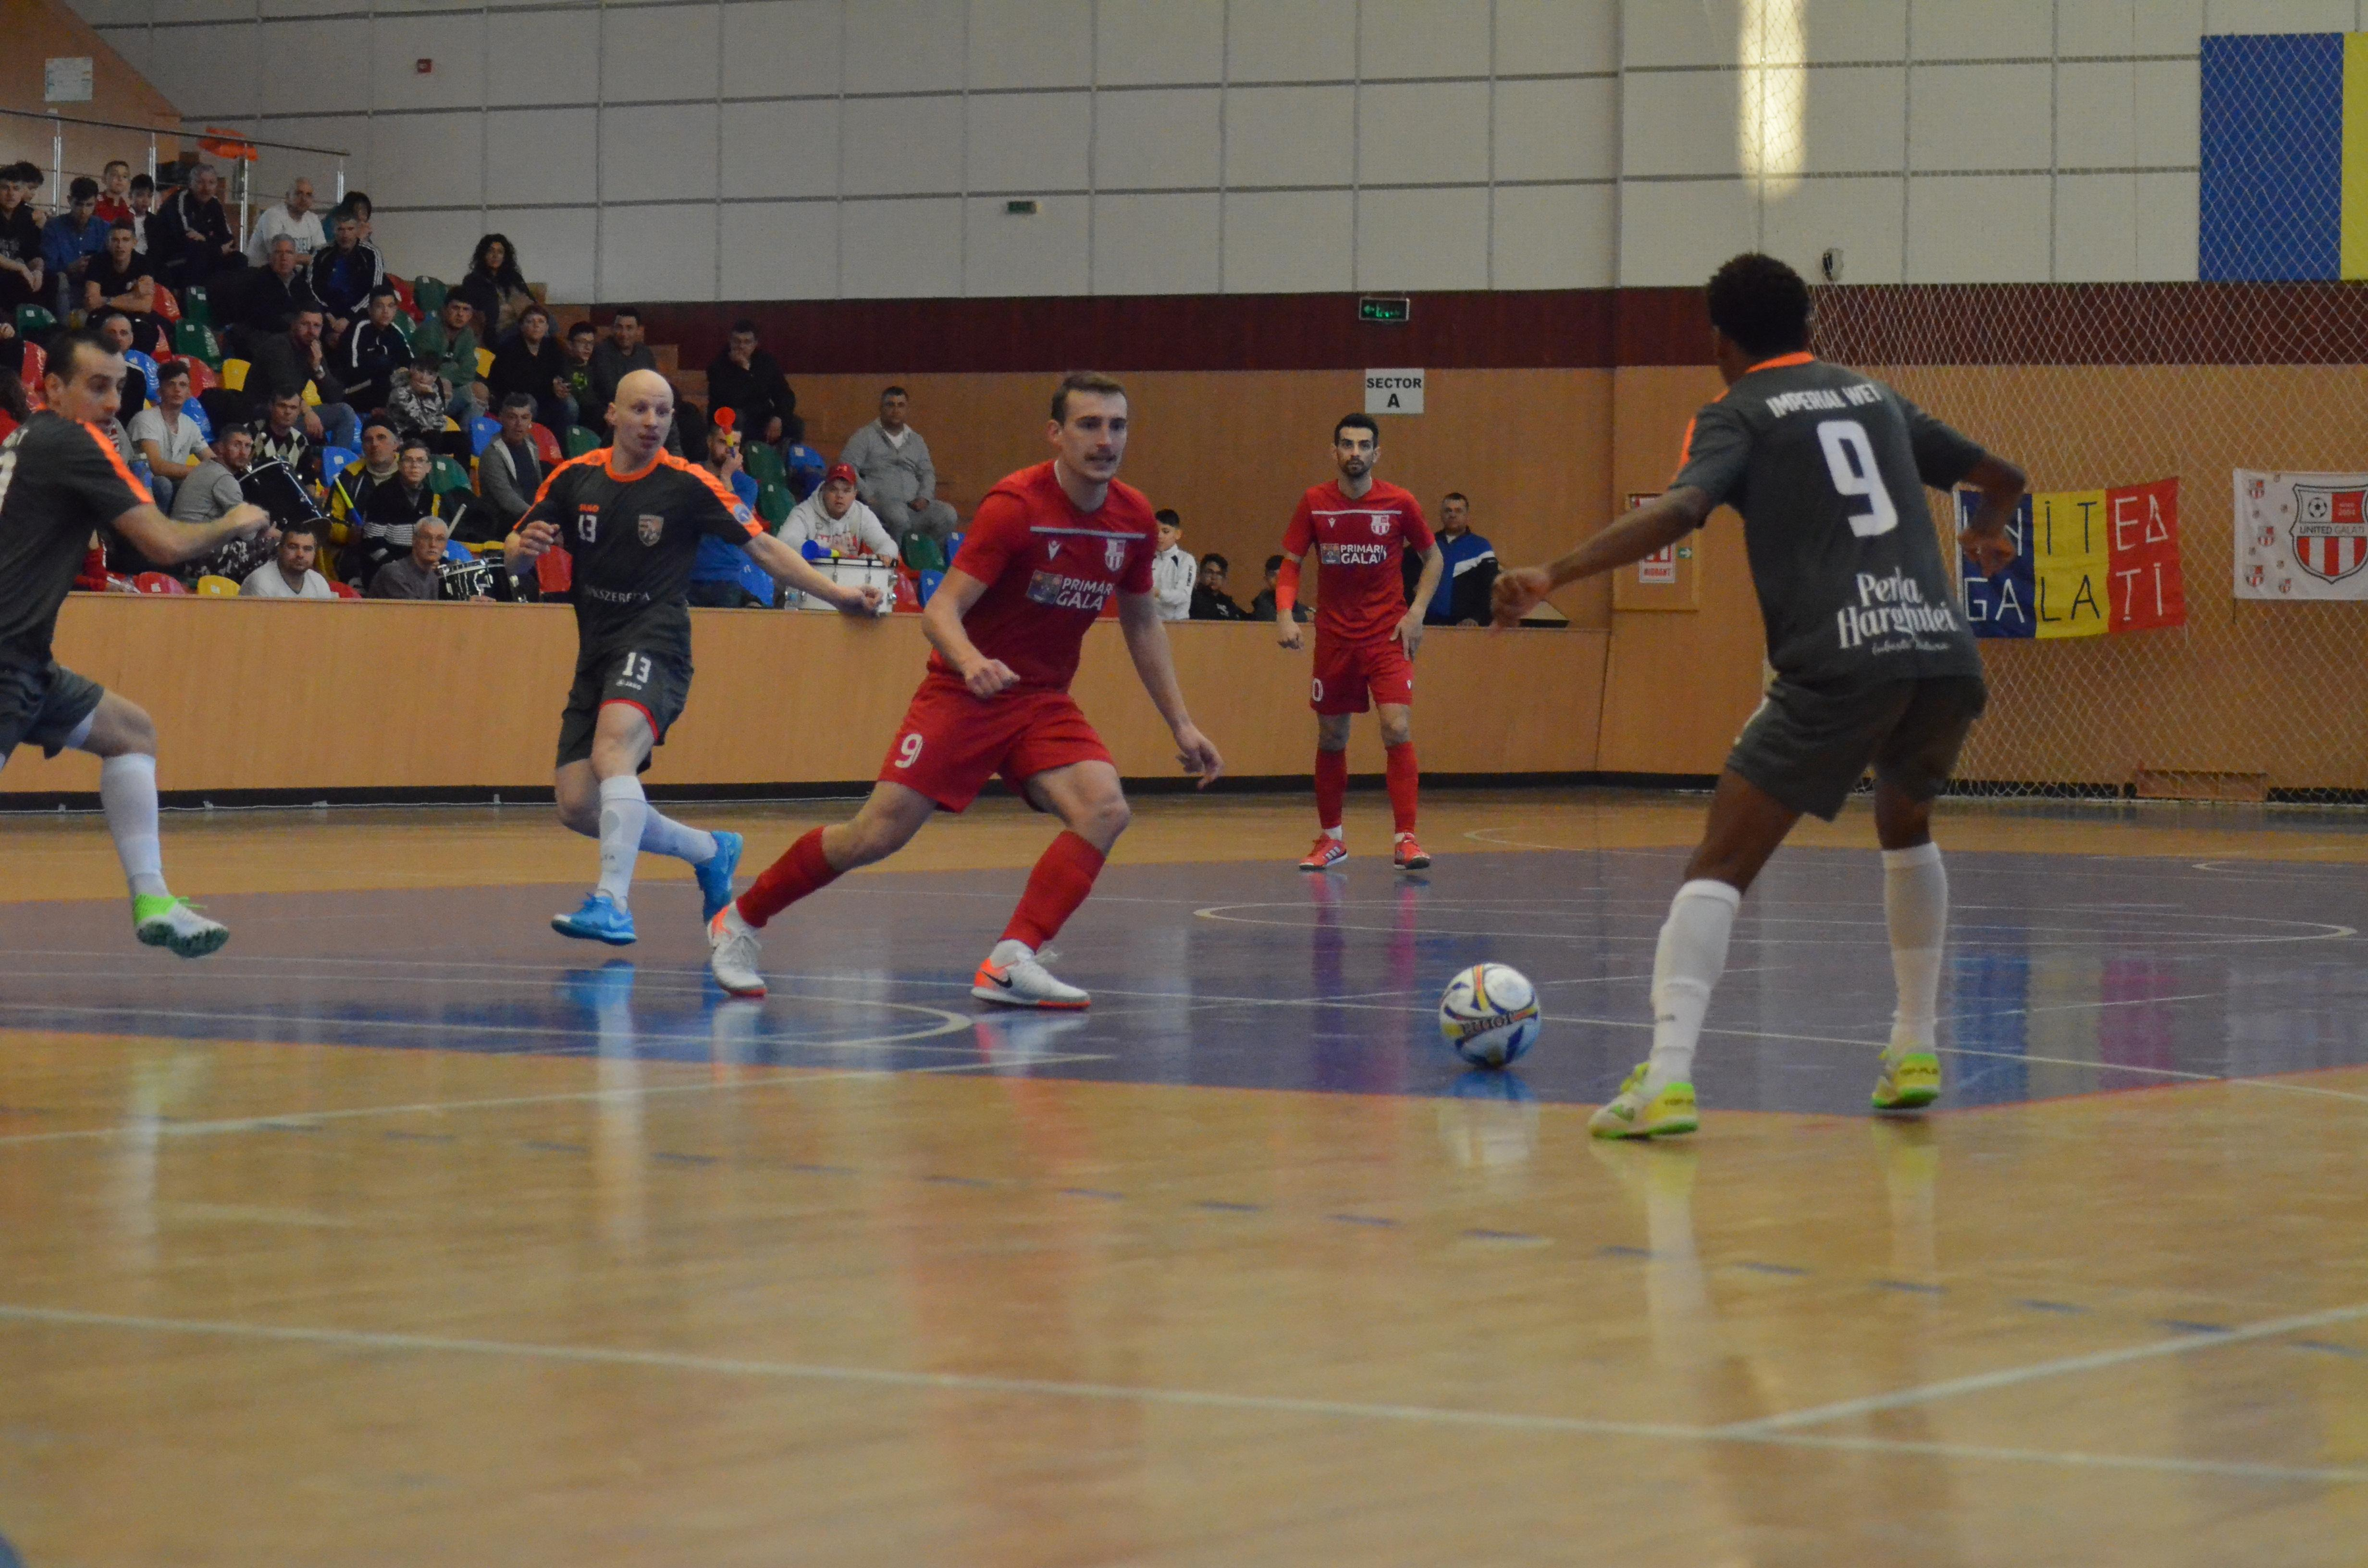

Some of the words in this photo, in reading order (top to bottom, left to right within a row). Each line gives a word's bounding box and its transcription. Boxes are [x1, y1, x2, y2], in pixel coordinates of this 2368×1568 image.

[1367, 378, 1421, 389] SECTOR
[1387, 393, 1400, 408] A
[1765, 389, 1846, 418] IMPERIAL
[1841, 384, 1882, 406] WET
[1817, 419, 1898, 538] 9
[578, 514, 597, 543] 13
[2300, 526, 2332, 535] UNITED
[1856, 566, 1922, 607] Perla
[622, 652, 652, 683] 13
[895, 733, 923, 768] 9
